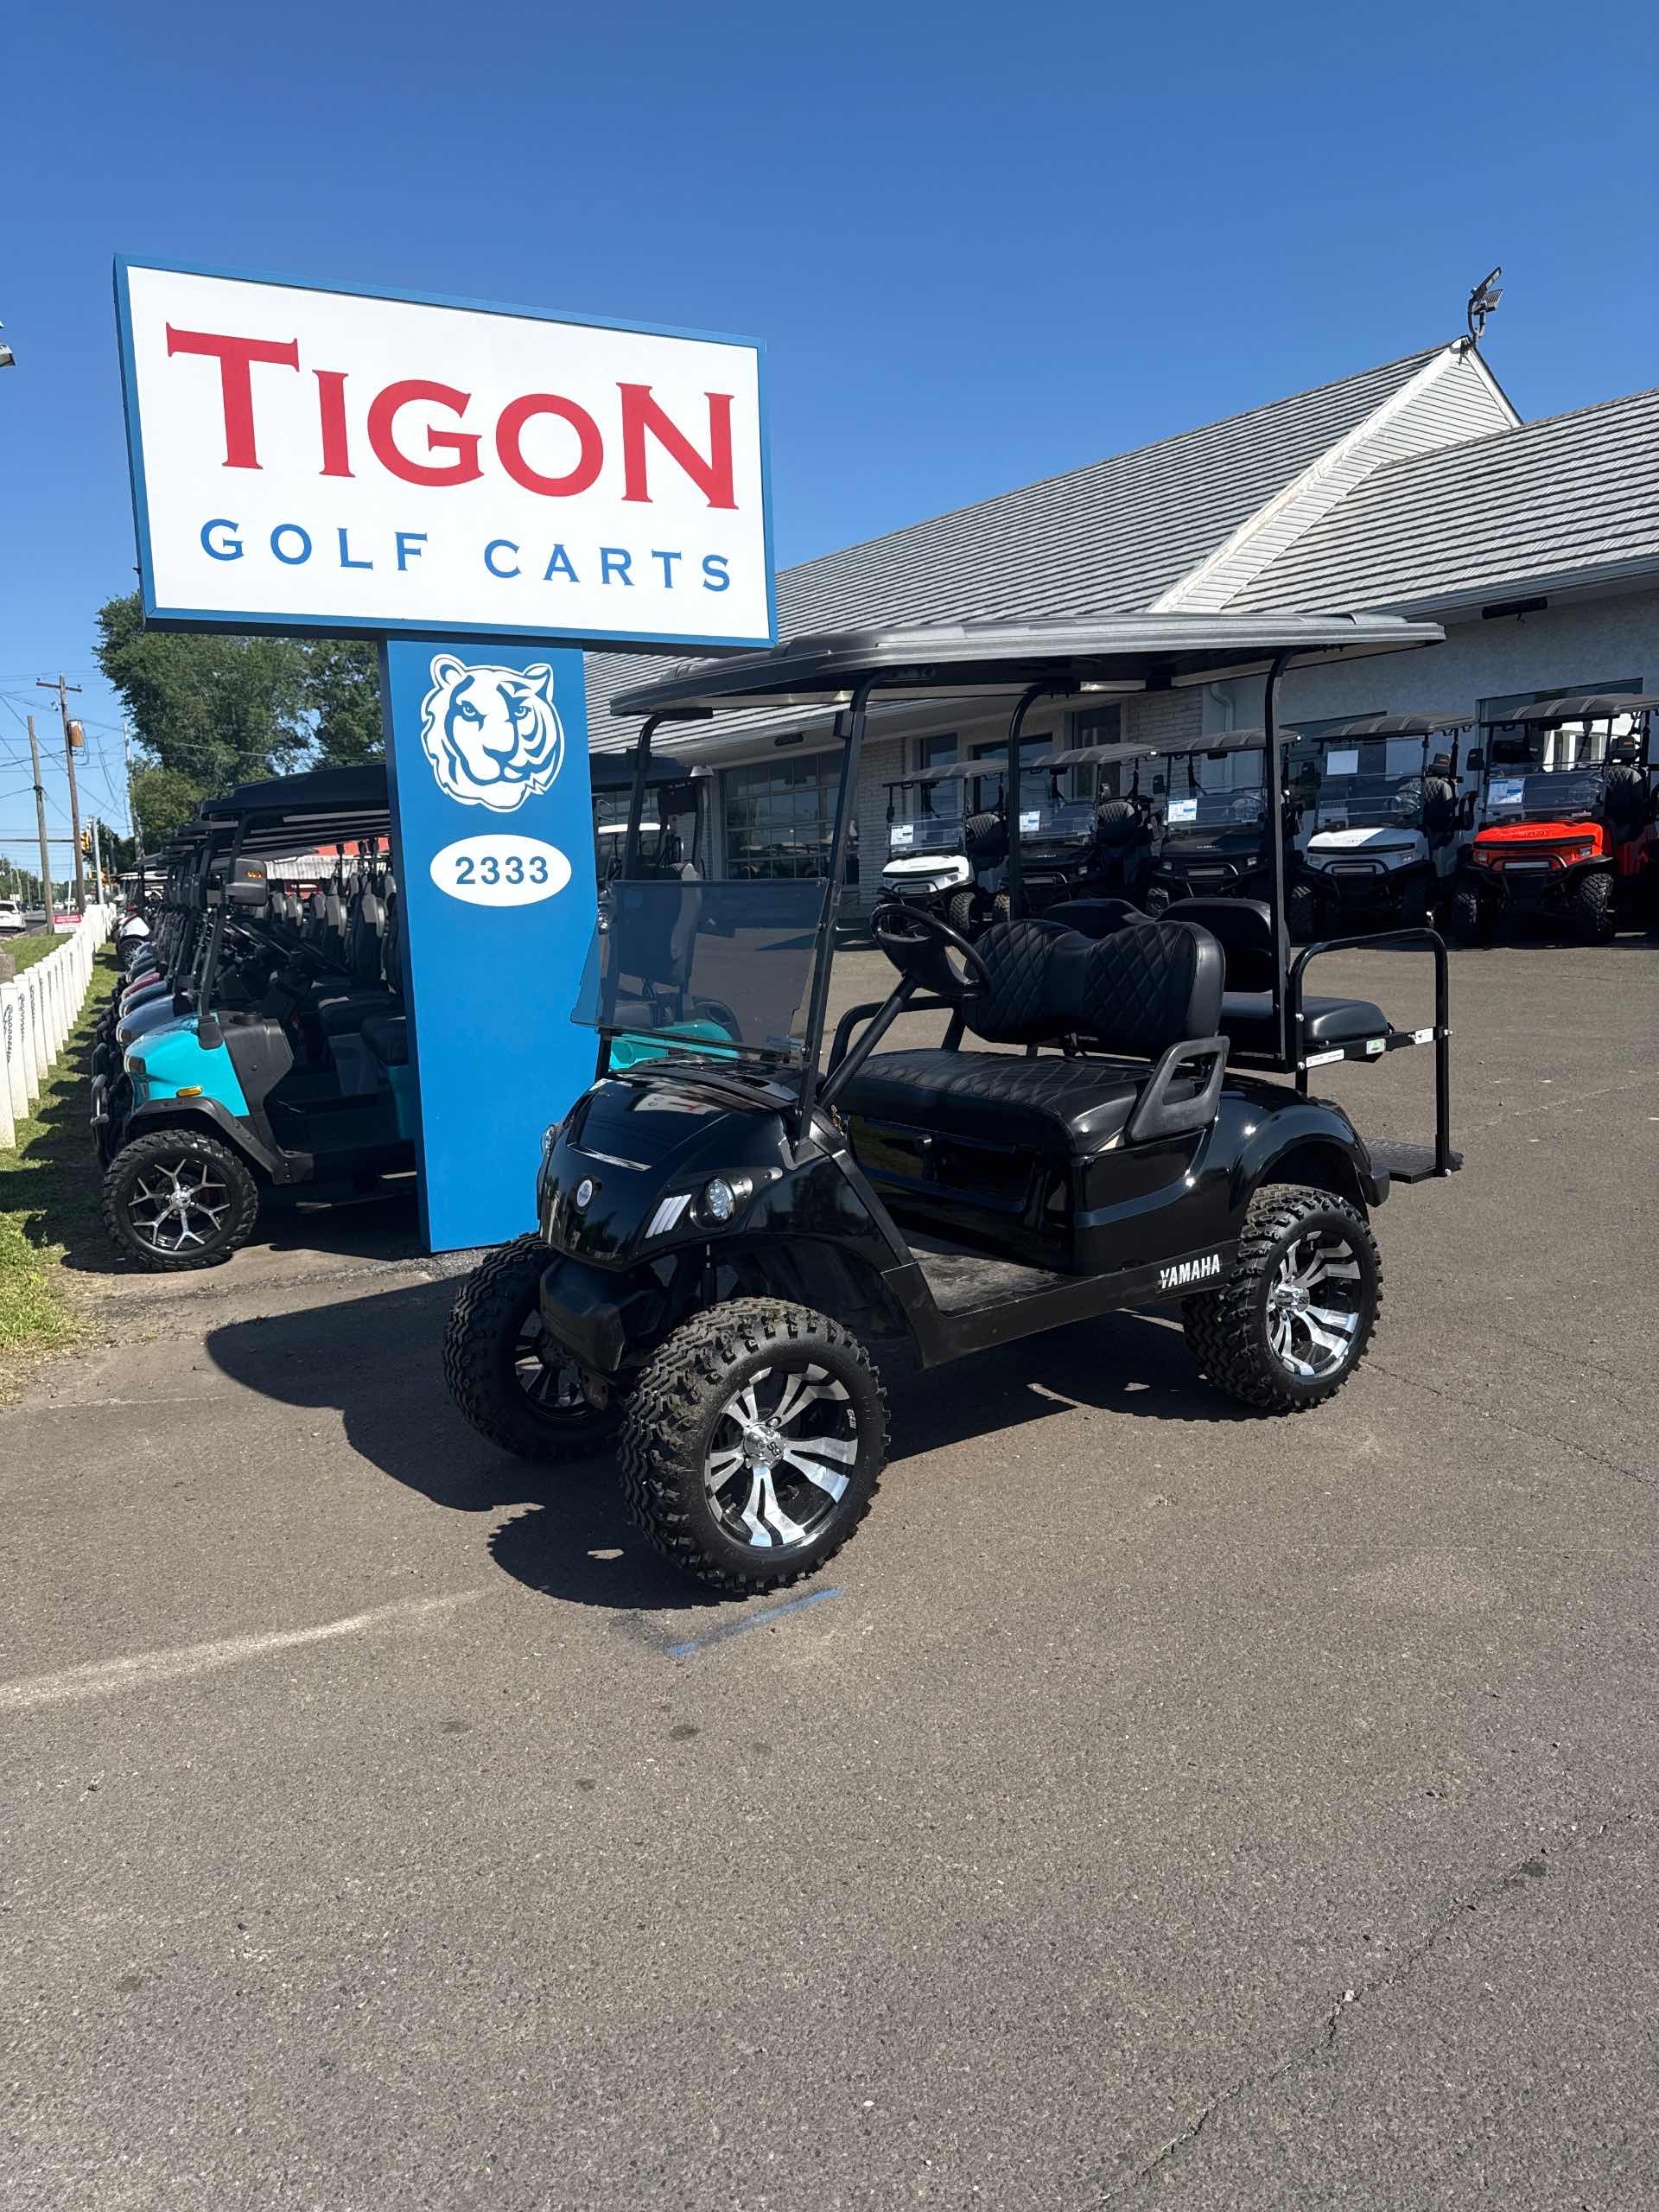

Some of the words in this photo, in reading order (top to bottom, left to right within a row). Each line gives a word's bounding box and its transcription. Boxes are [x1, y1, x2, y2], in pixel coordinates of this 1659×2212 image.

[165, 321, 739, 510] TIGON
[200, 518, 428, 572] GOLF
[483, 538, 731, 593] CARTS
[455, 856, 549, 885] 2333
[1160, 1253, 1220, 1289] YAMAHA
